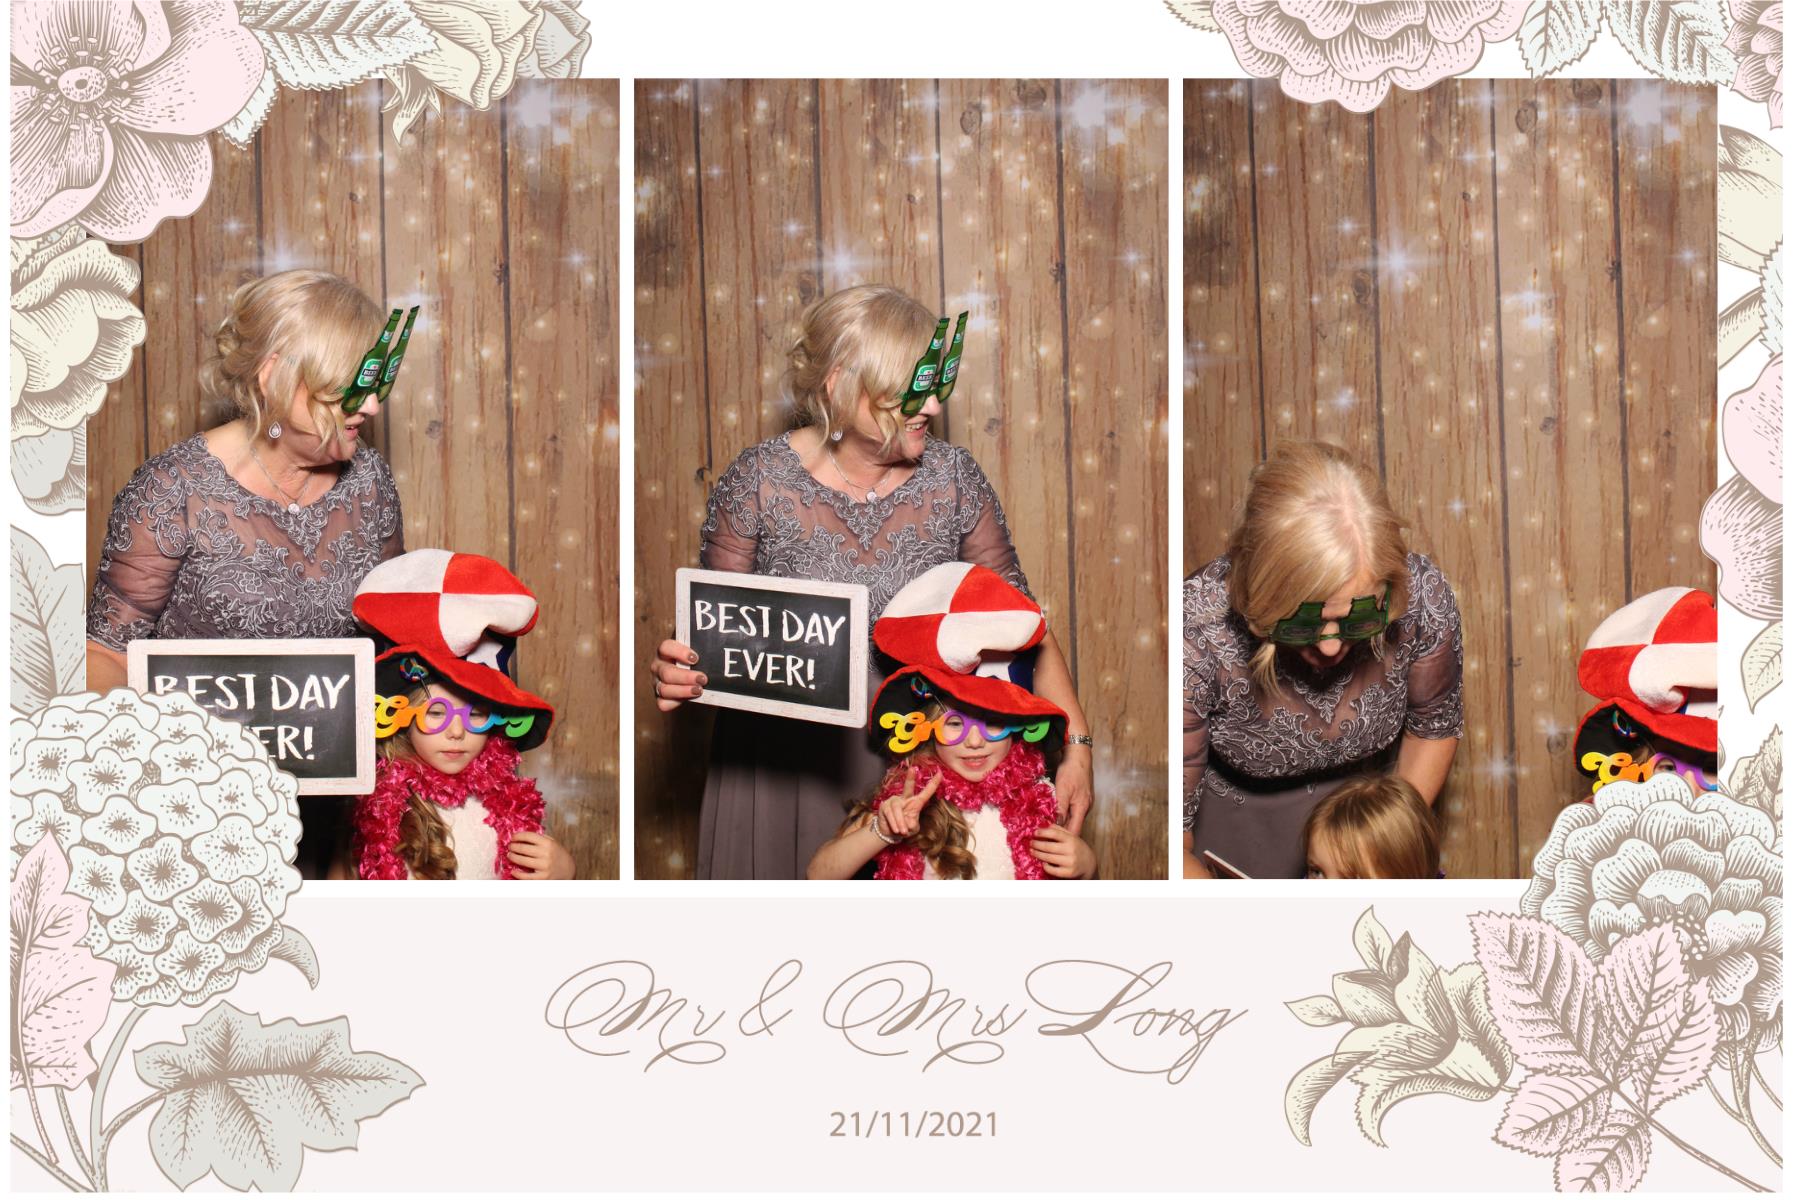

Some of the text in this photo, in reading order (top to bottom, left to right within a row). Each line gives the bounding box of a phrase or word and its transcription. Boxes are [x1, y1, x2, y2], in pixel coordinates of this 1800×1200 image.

[694, 600, 846, 647] BEST DAY
[723, 647, 816, 690] EVER!
[271, 673, 351, 711] DAY
[248, 725, 315, 761] ER!
